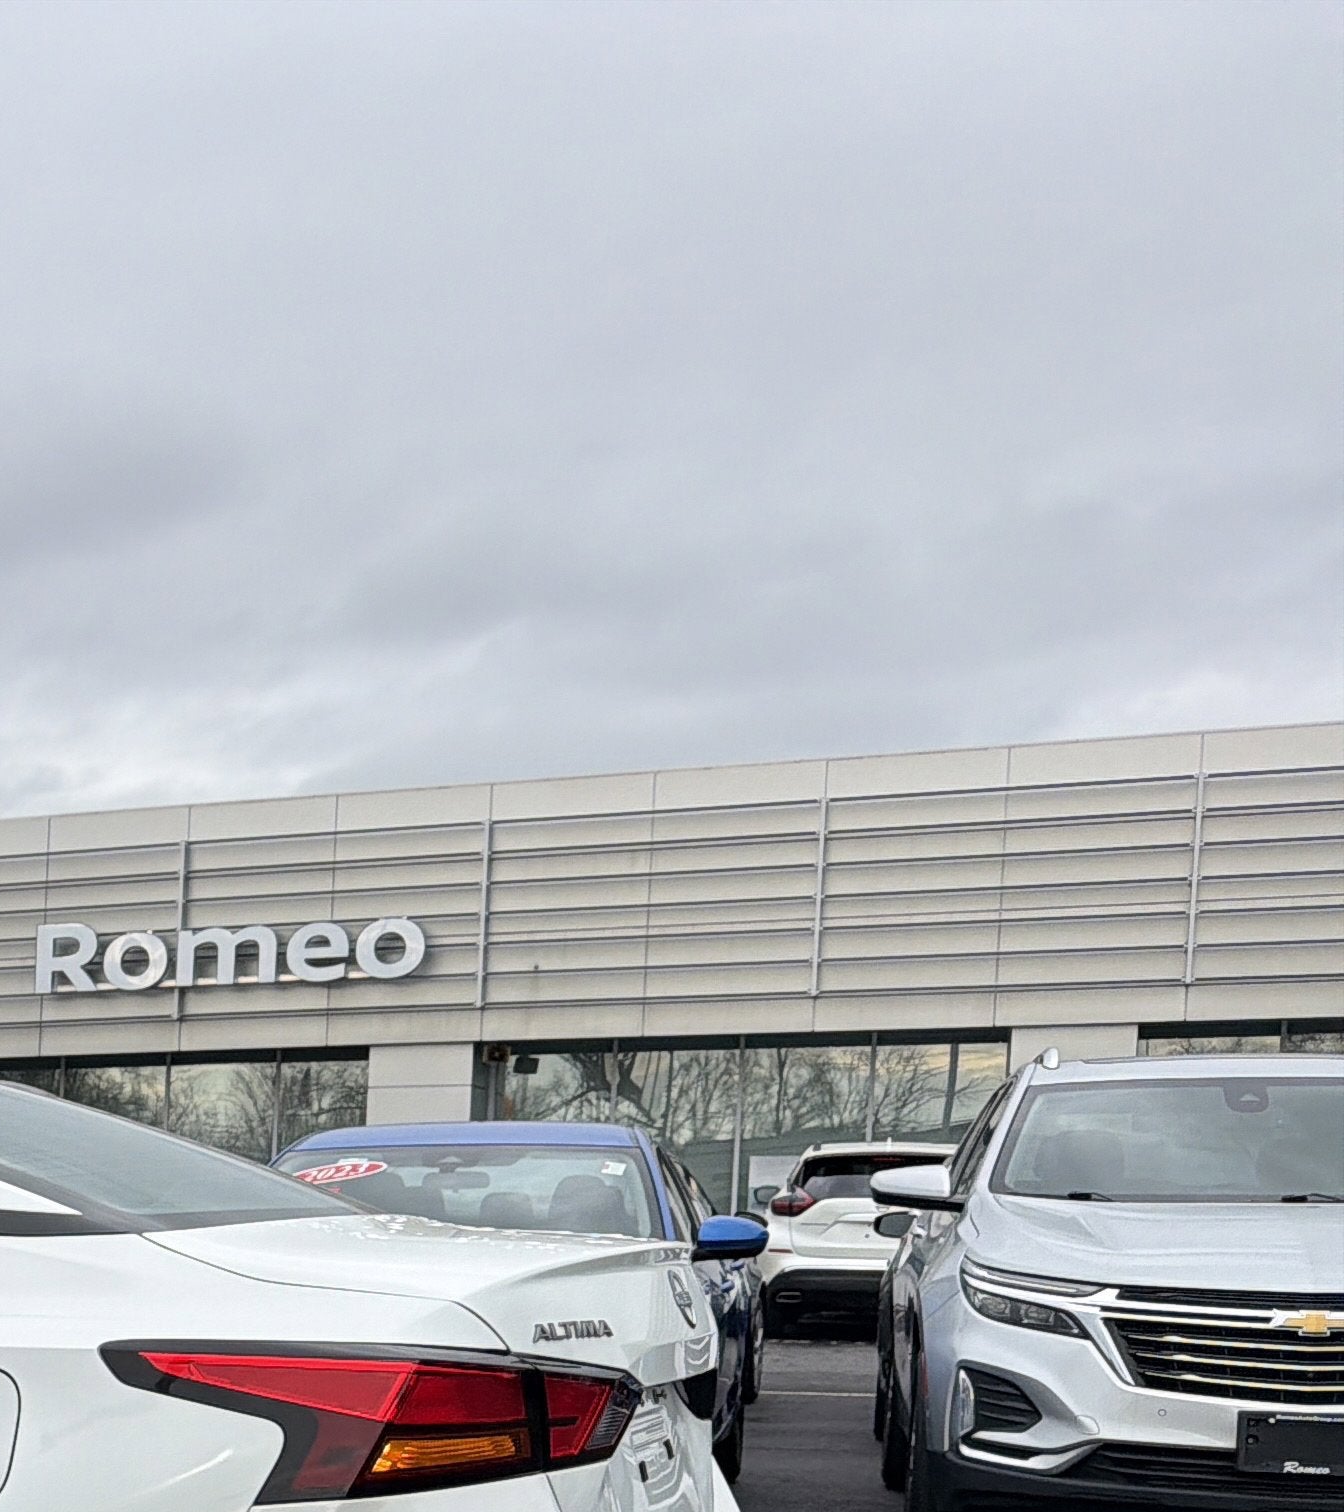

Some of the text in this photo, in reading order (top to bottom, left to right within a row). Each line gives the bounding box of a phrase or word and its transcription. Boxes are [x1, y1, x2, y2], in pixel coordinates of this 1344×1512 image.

[34, 916, 426, 994] Romeo
[532, 1320, 614, 1343] ALTIMA
[1282, 1461, 1331, 1474] Romeo
